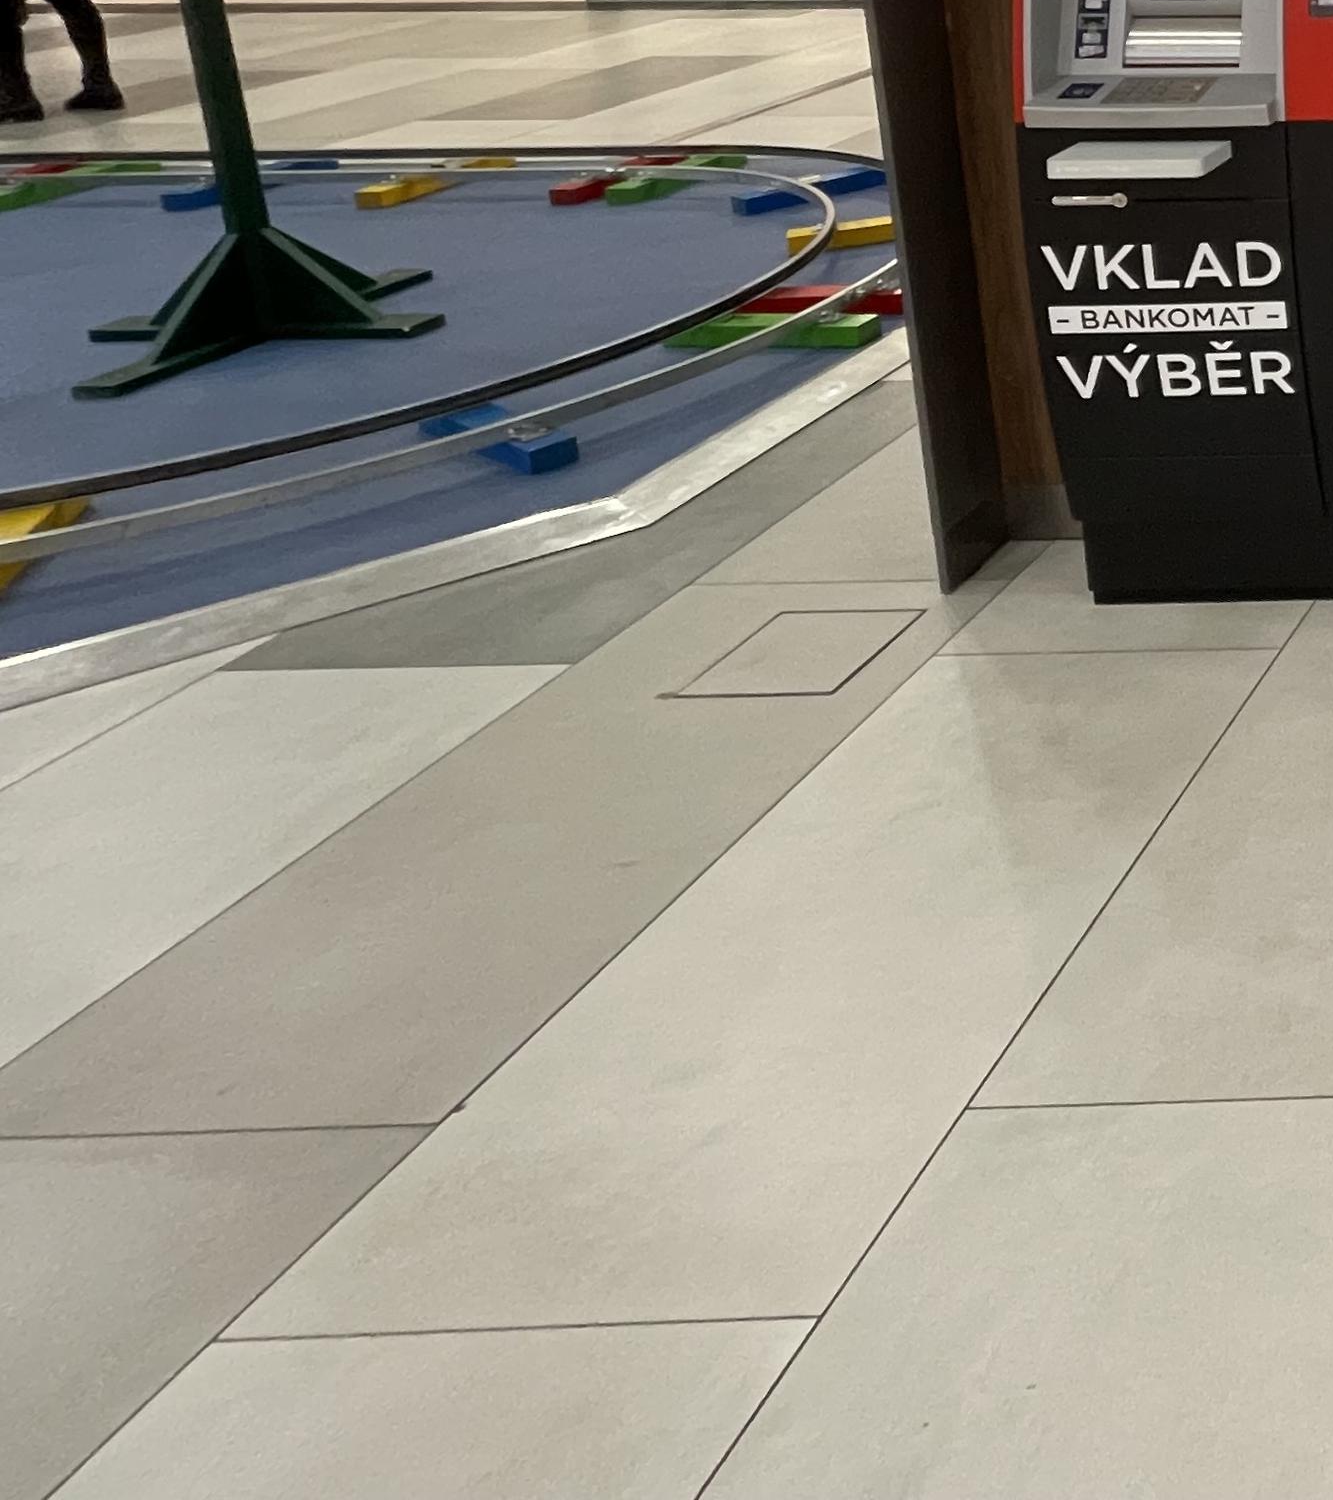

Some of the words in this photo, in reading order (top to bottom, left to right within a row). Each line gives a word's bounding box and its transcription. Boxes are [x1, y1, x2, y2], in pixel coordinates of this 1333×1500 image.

[1040, 241, 1282, 291] VKLAD
[1080, 306, 1256, 330] BANKOMAT
[1056, 340, 1296, 399] VÝBĚR
